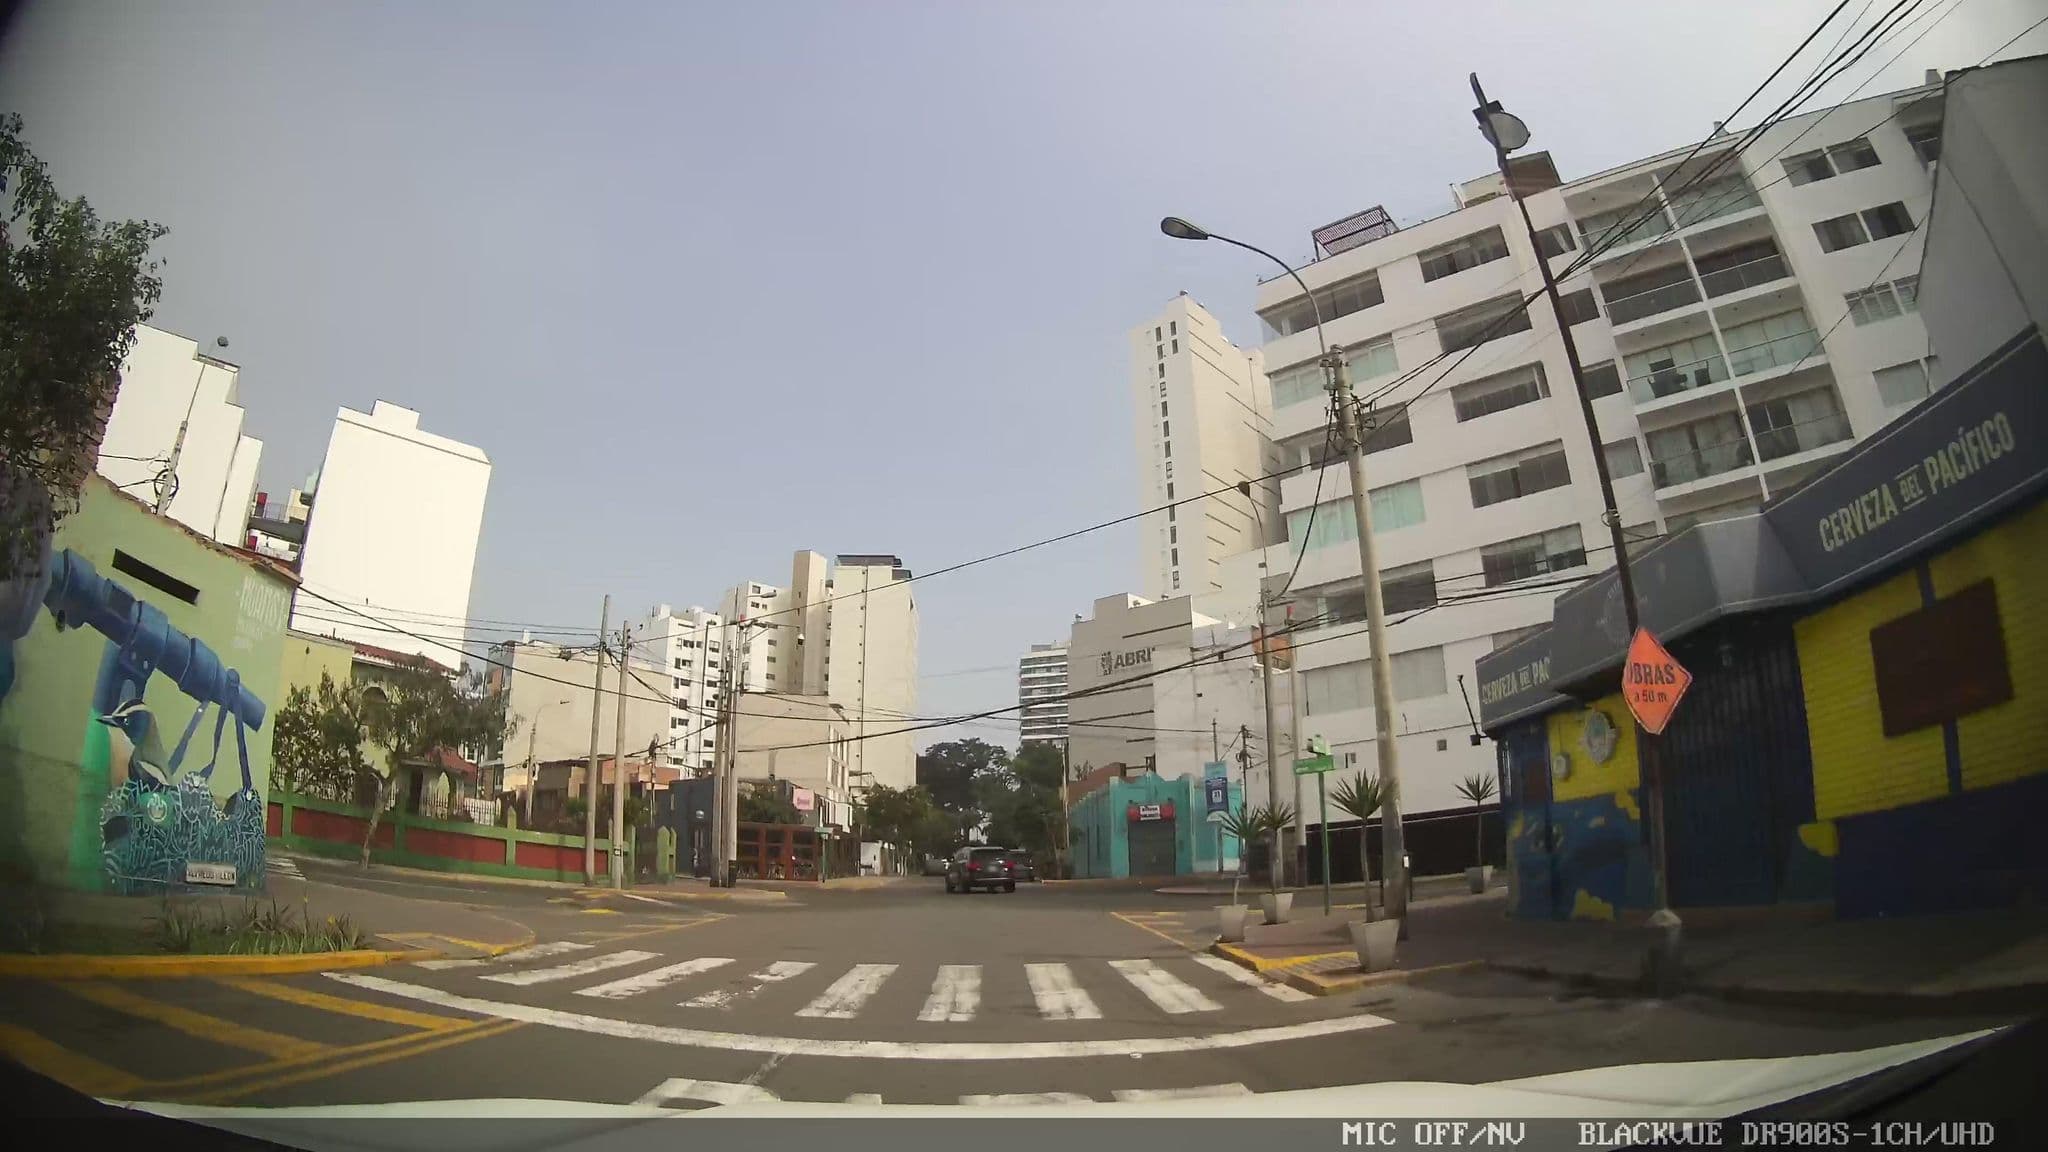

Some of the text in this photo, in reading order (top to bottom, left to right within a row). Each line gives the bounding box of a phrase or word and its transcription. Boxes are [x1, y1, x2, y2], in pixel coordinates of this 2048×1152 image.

[1818, 411, 2015, 552] CERVEZA DEL PACÍFICO
[1113, 647, 1156, 669] ABRI
[1481, 671, 1520, 705] CERVEZA
